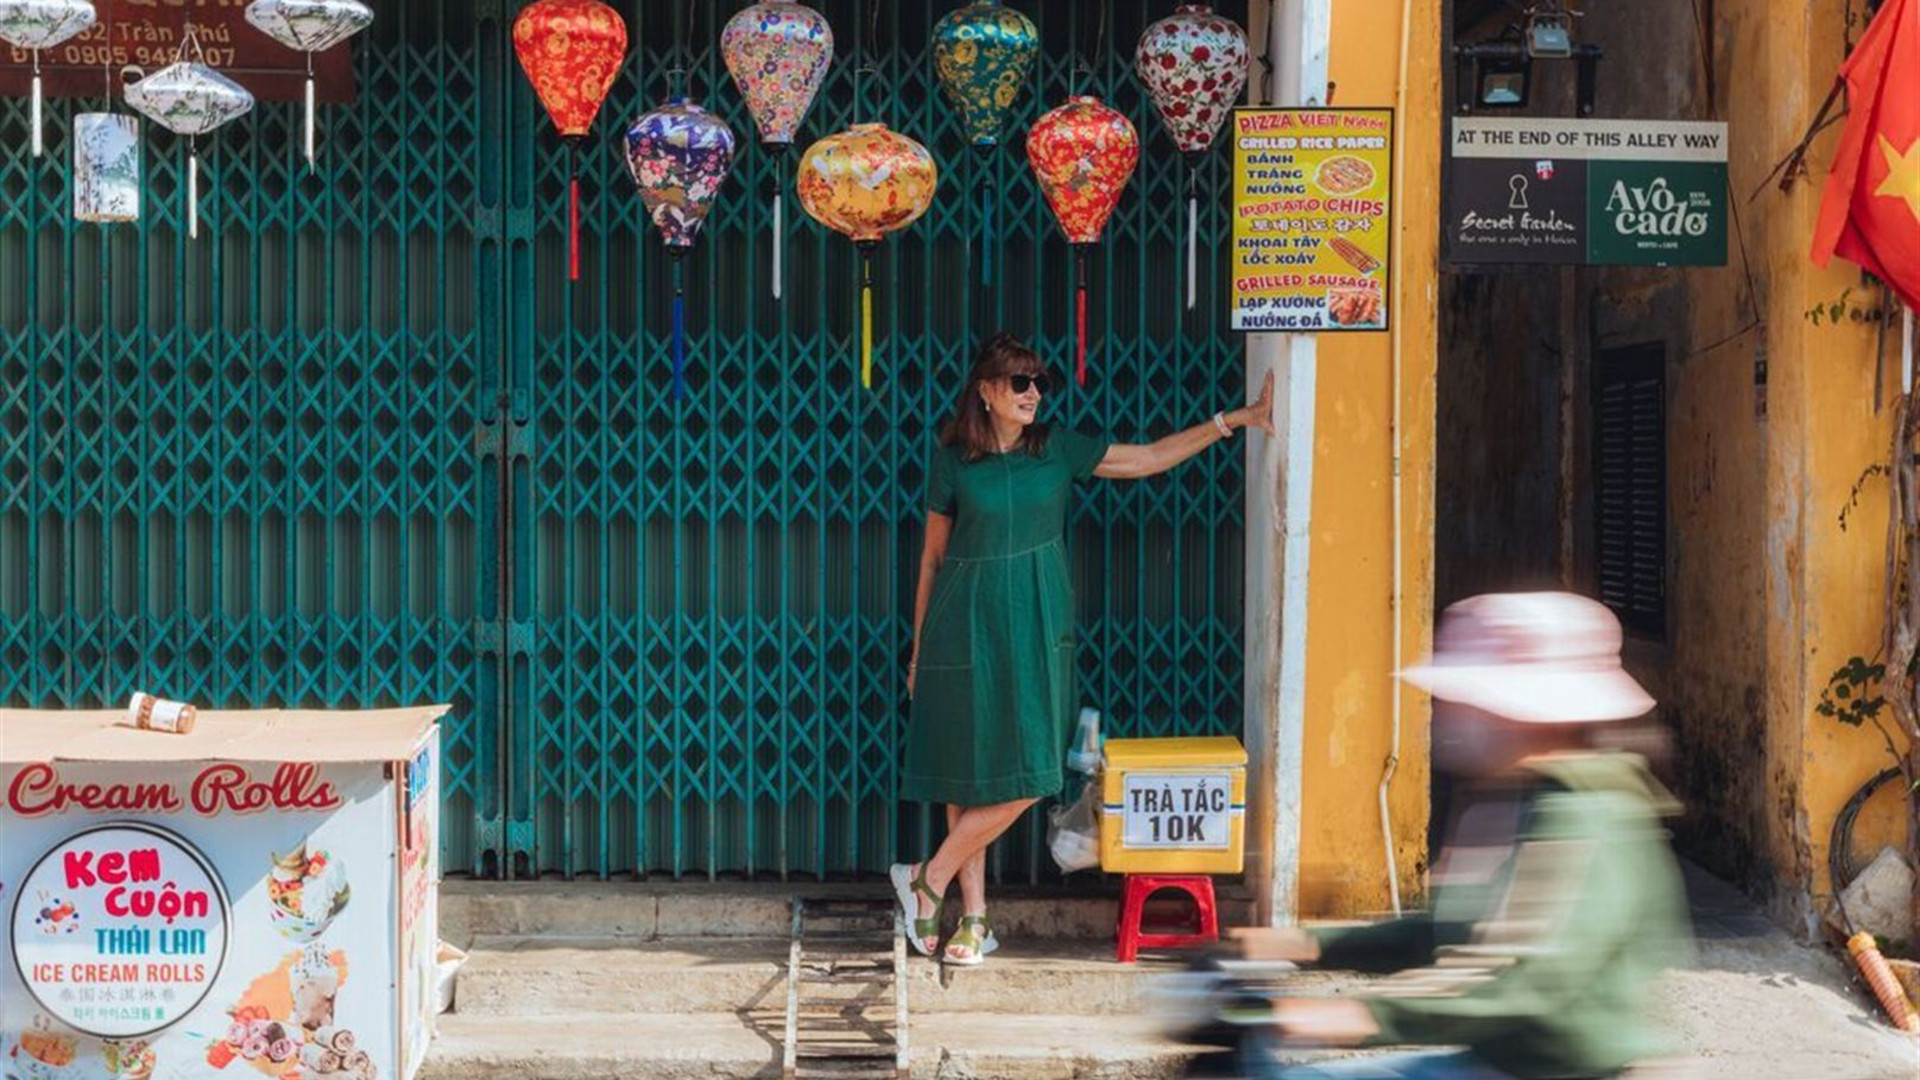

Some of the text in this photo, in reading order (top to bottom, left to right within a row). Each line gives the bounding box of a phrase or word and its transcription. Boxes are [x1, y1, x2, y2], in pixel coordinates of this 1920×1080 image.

[116, 19, 173, 42] Trần
[65, 47, 129, 64] 0905
[1239, 114, 1293, 133] PIZZA
[1239, 137, 1385, 149] GRILLED RICE PAPER
[1458, 129, 1719, 148] AT THE END OF THIS ALLEY WAY
[1247, 152, 1293, 164] BÁNH
[1247, 167, 1303, 179] TRÁNG
[1604, 177, 1675, 212] Avo
[1239, 199, 1384, 217] POTATO CHIPS
[1460, 209, 1575, 231] Secret Garden
[1615, 201, 1708, 236] cado
[1238, 235, 1321, 248] KHOAI TÂY
[1275, 252, 1316, 264] XOÁY
[1237, 275, 1378, 291] GRILLED SAUSAGE
[1239, 297, 1267, 312] LẠP
[1300, 311, 1323, 327] ĐÁ
[8, 762, 340, 816] Cream Rolls
[1130, 779, 1225, 813] TRÀ TẮC
[1149, 815, 1205, 842] 10K
[95, 924, 150, 954] THÁI
[33, 964, 205, 982] ICE CREAM ROLLS
